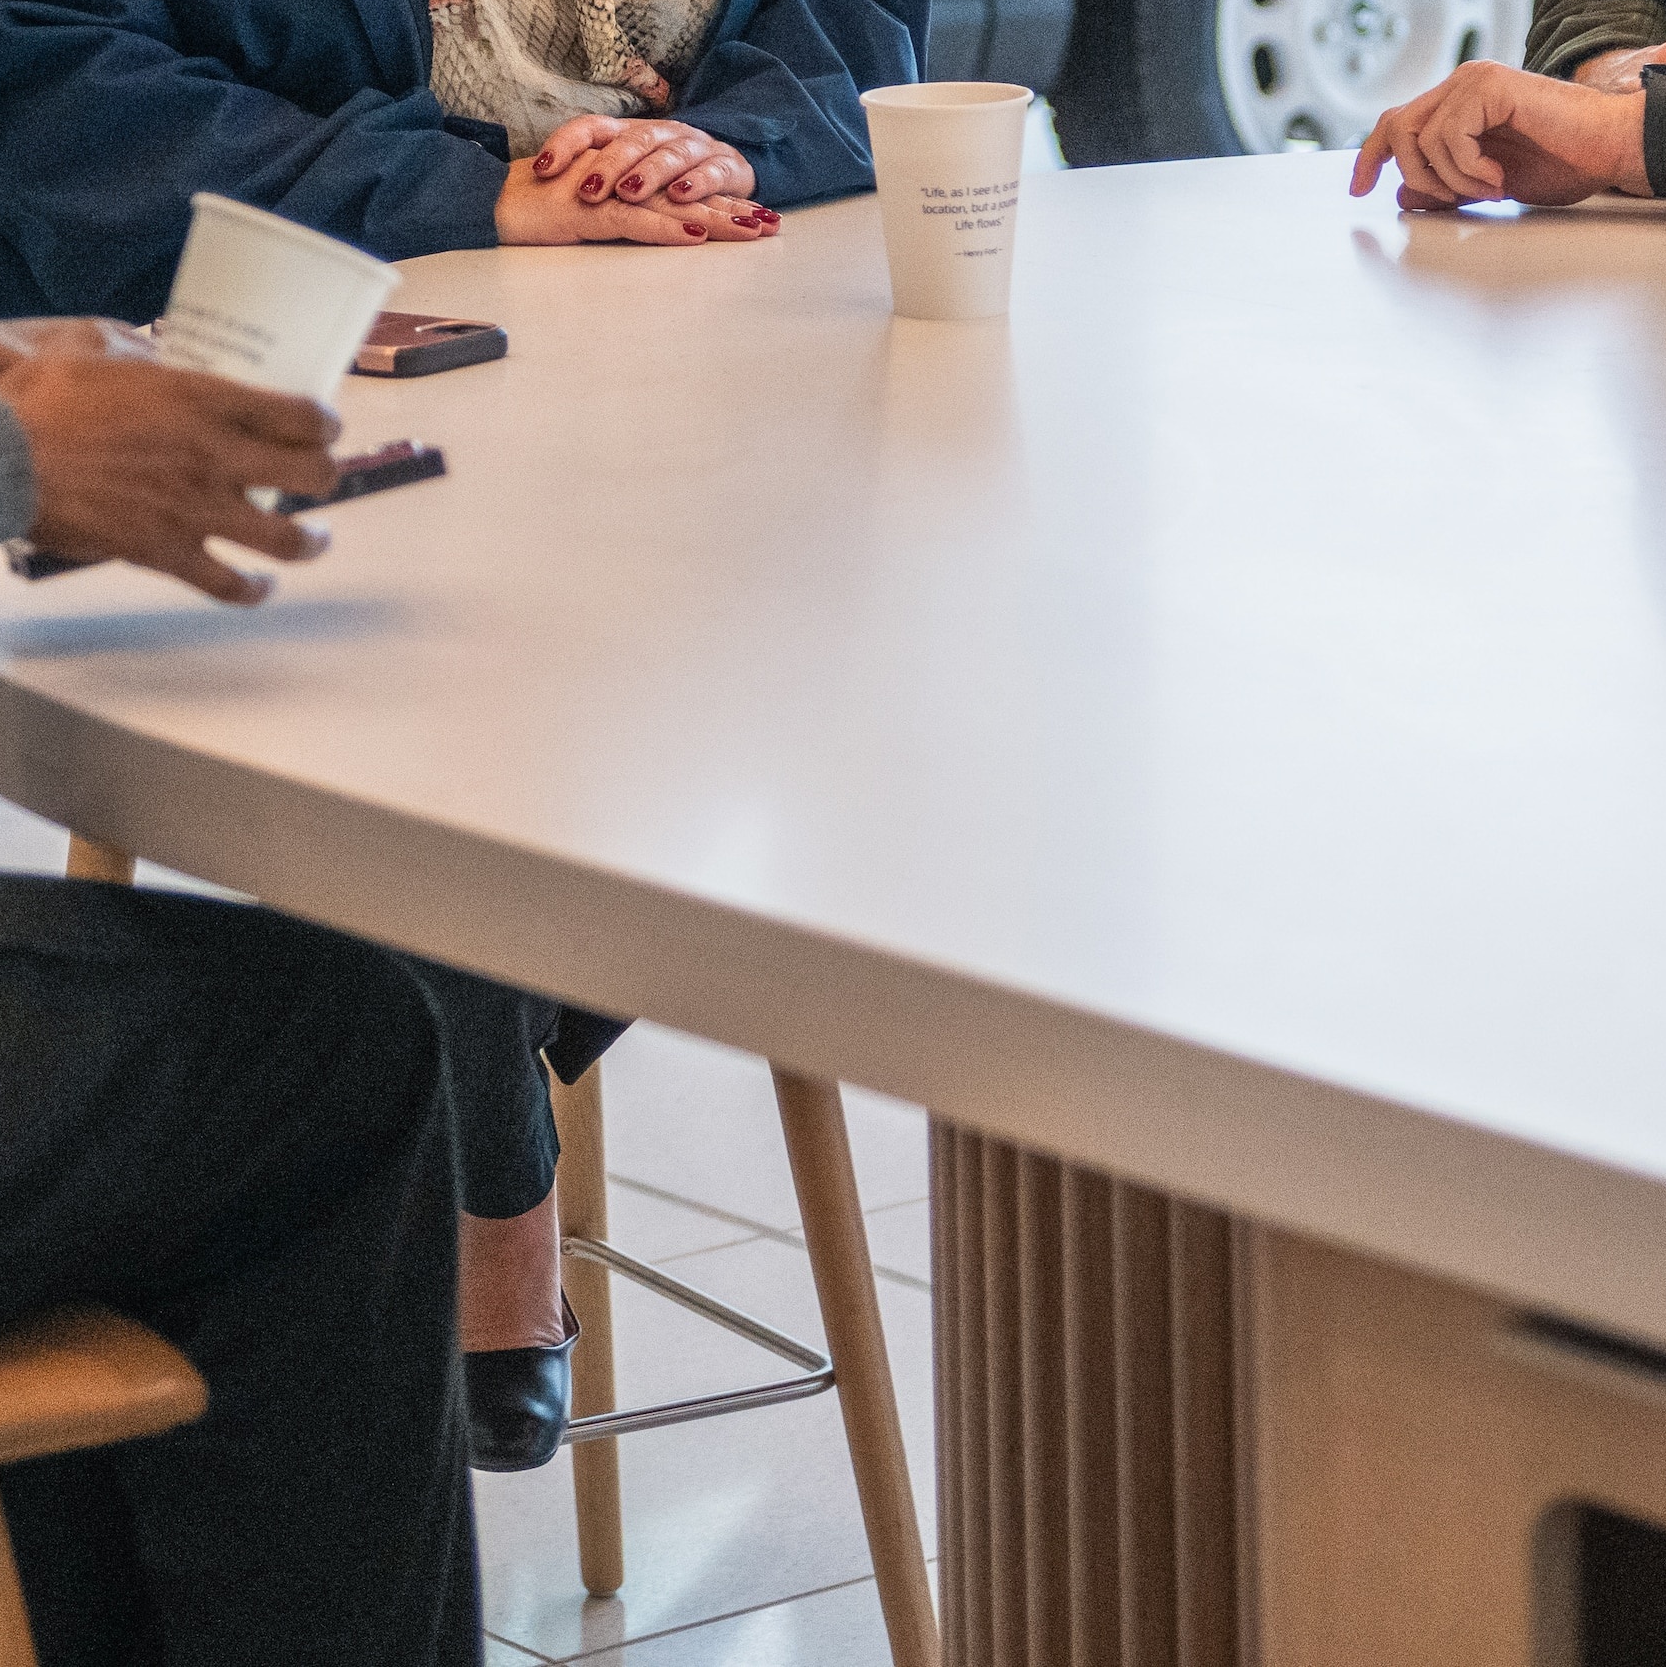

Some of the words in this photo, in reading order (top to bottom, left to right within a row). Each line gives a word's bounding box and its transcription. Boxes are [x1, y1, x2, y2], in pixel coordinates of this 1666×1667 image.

[950, 188, 963, 198] as
[973, 187, 990, 196] see
[922, 203, 968, 215] location,
[971, 202, 988, 213] but
[991, 202, 997, 211] a
[955, 219, 974, 231] Life
